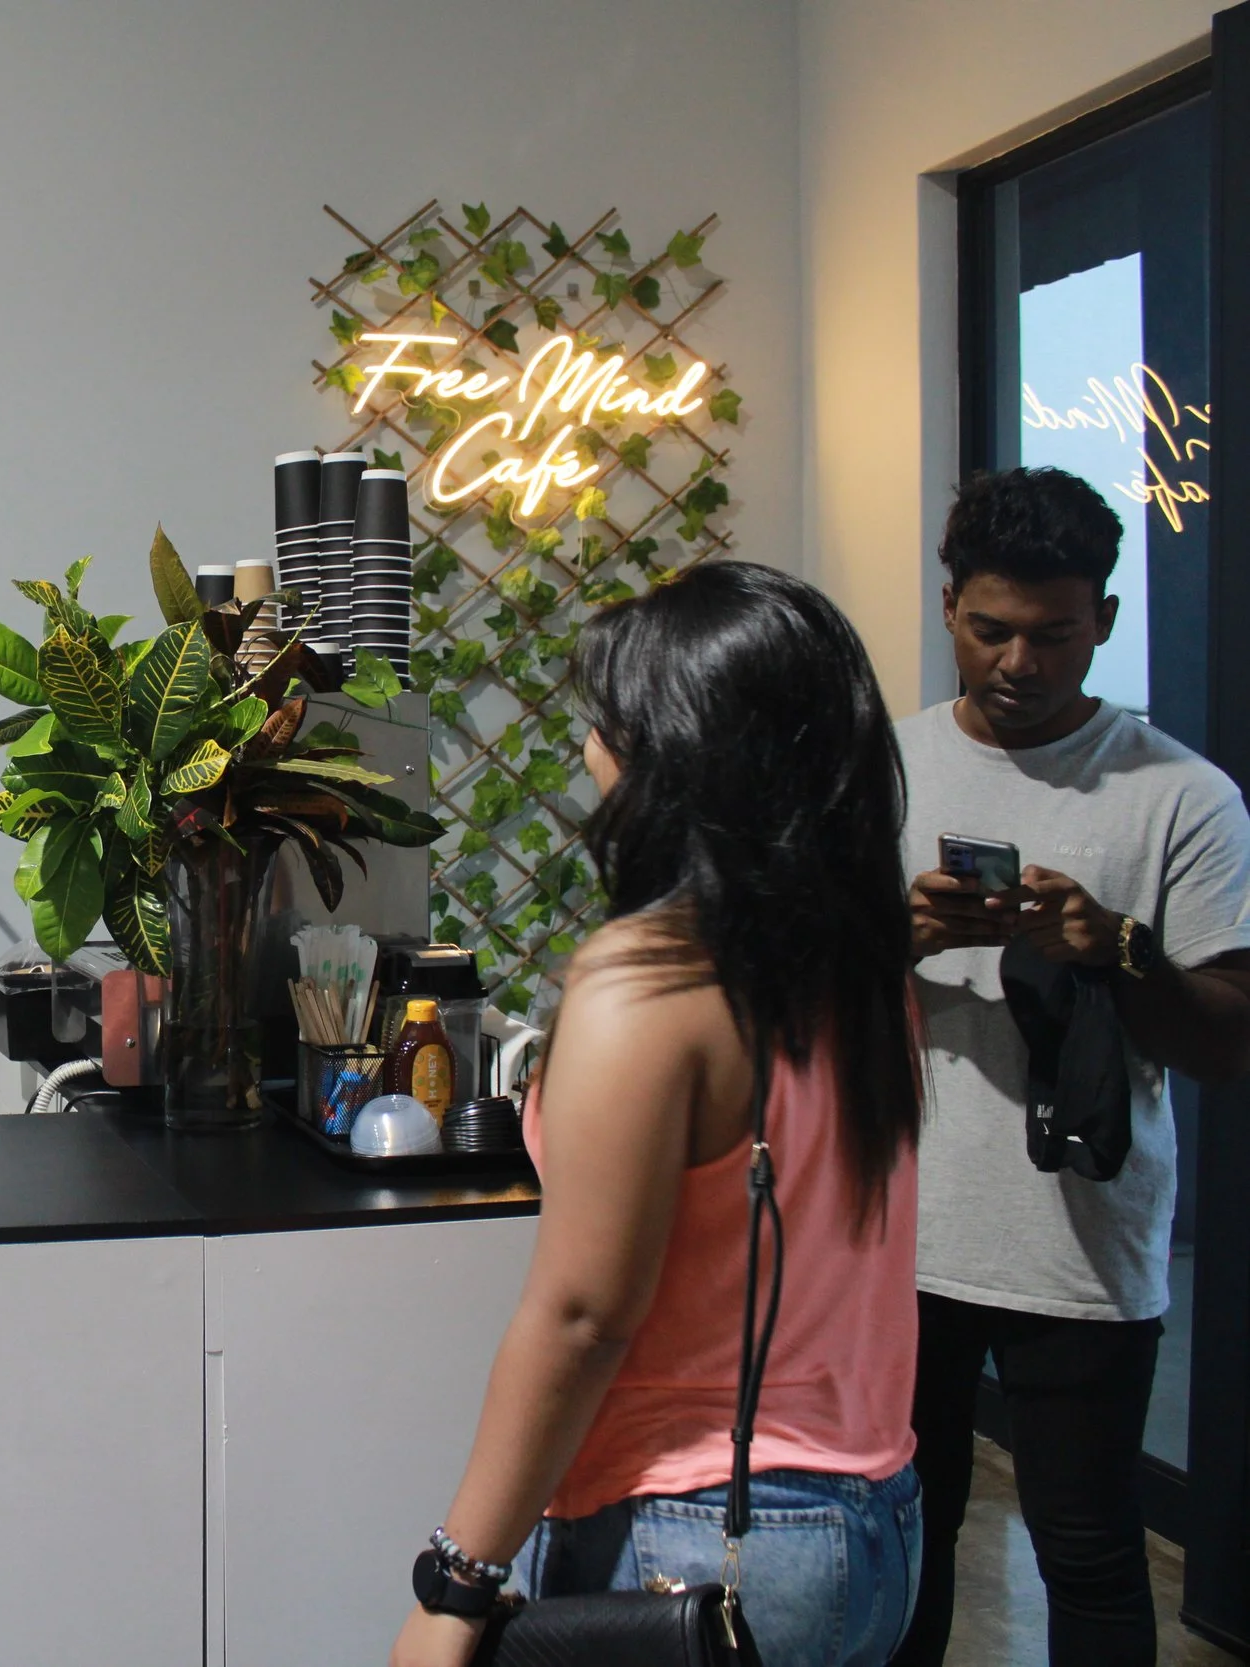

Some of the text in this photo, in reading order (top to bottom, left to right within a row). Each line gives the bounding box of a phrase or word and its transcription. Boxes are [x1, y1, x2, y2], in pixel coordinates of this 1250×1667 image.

[351, 332, 706, 442] Free Mind
[432, 411, 600, 517] Café
